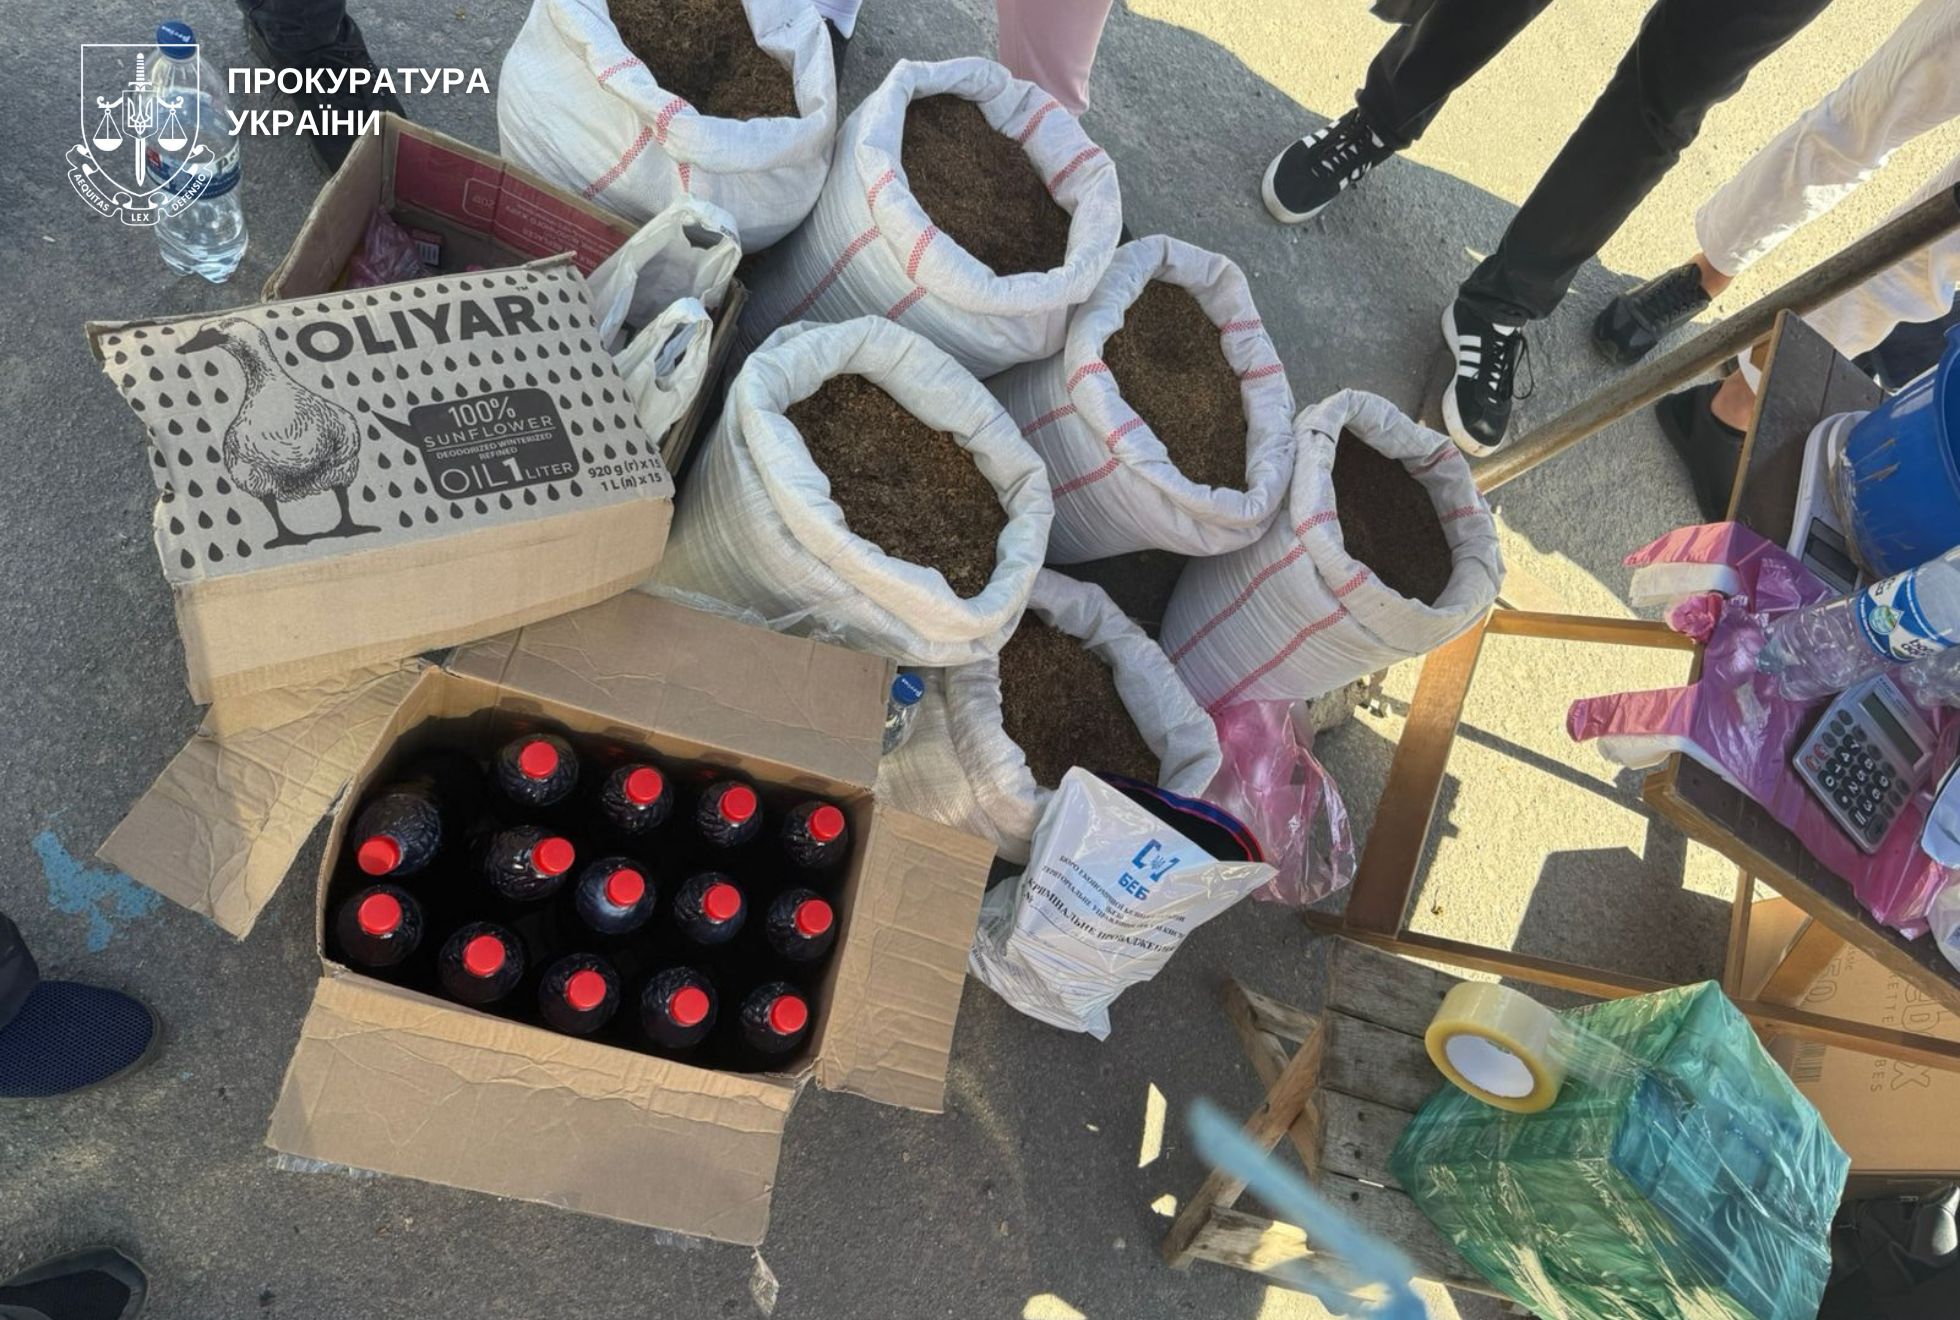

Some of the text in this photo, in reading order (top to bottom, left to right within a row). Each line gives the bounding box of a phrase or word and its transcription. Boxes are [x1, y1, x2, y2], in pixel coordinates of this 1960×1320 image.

[296, 294, 544, 362] OLIYAR
[448, 396, 516, 428] 100%
[424, 415, 554, 448] SUNFLOWER
[436, 432, 553, 460] DEODORIZED WINTERIZED
[478, 447, 518, 461] REFINED
[440, 457, 574, 494] OIL 1 LITER
[588, 465, 612, 478] 920
[614, 465, 623, 476] g
[601, 481, 608, 491] 1
[611, 479, 620, 490] L
[648, 472, 662, 483] 15
[1118, 872, 1150, 901] БЕБ
[1028, 877, 1096, 935] КРИМІНАЛЬНЕ
